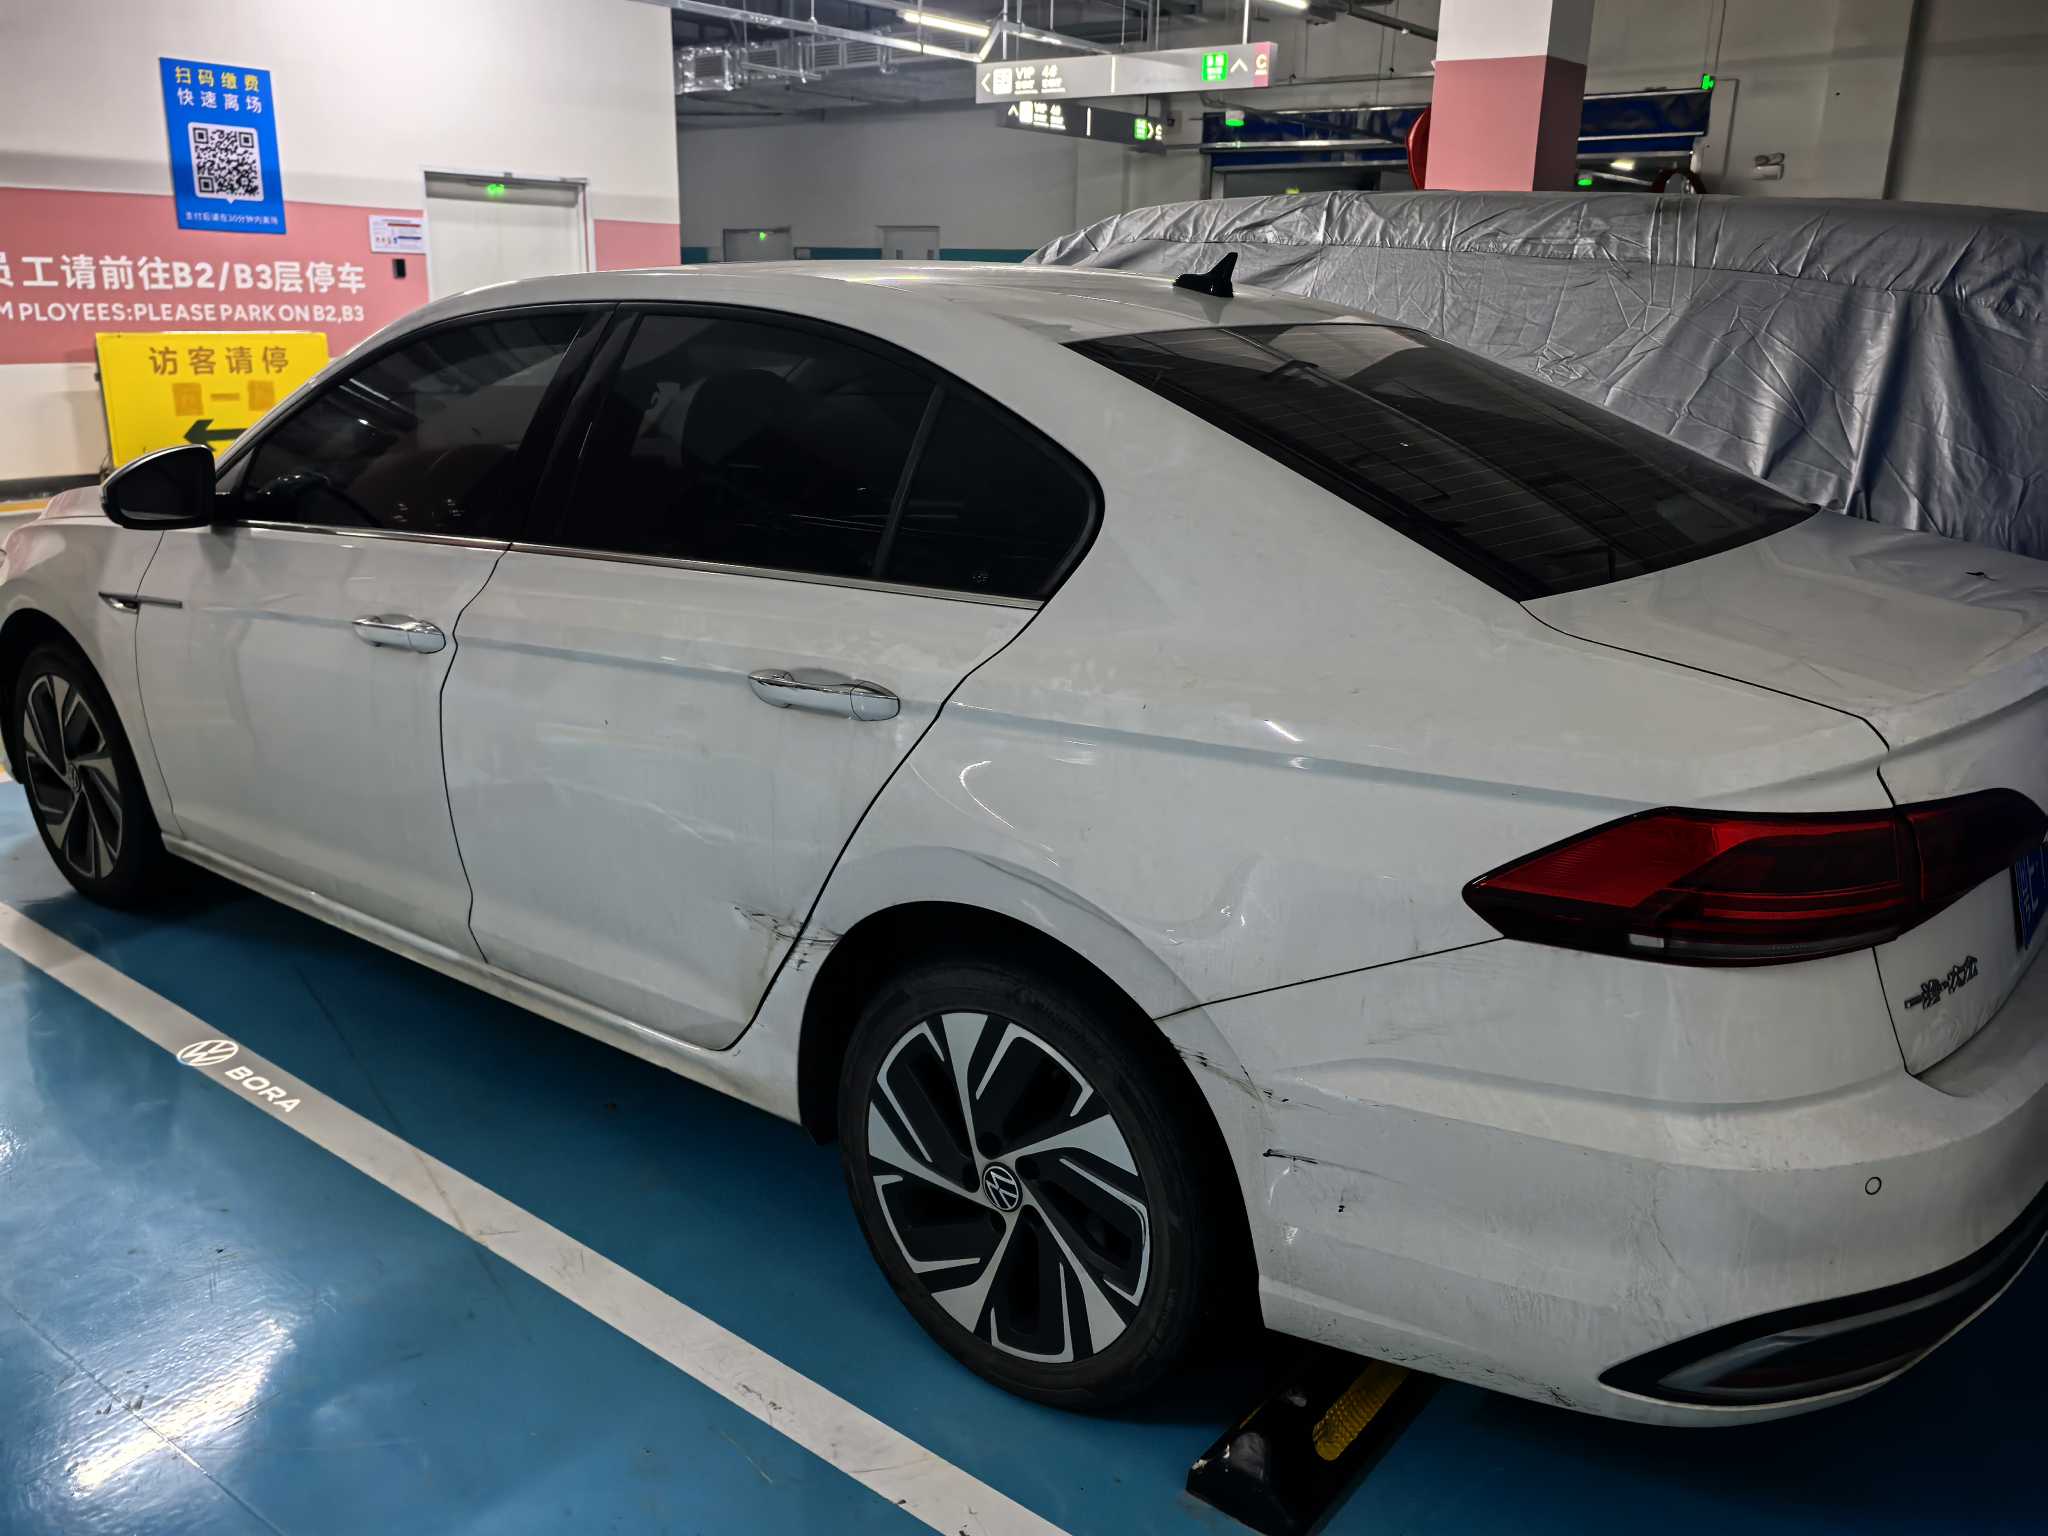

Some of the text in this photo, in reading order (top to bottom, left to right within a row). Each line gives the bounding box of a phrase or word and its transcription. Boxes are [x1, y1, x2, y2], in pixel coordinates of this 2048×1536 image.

[175, 66, 259, 92] 扫码缴费
[1015, 66, 1035, 79] VIP
[177, 87, 262, 114] 快速离场
[219, 304, 276, 322] PARK
[278, 304, 311, 322] ON
[313, 304, 365, 324] B2,B3
[149, 346, 289, 375] 访客请停
[224, 1065, 302, 1113] BORA
